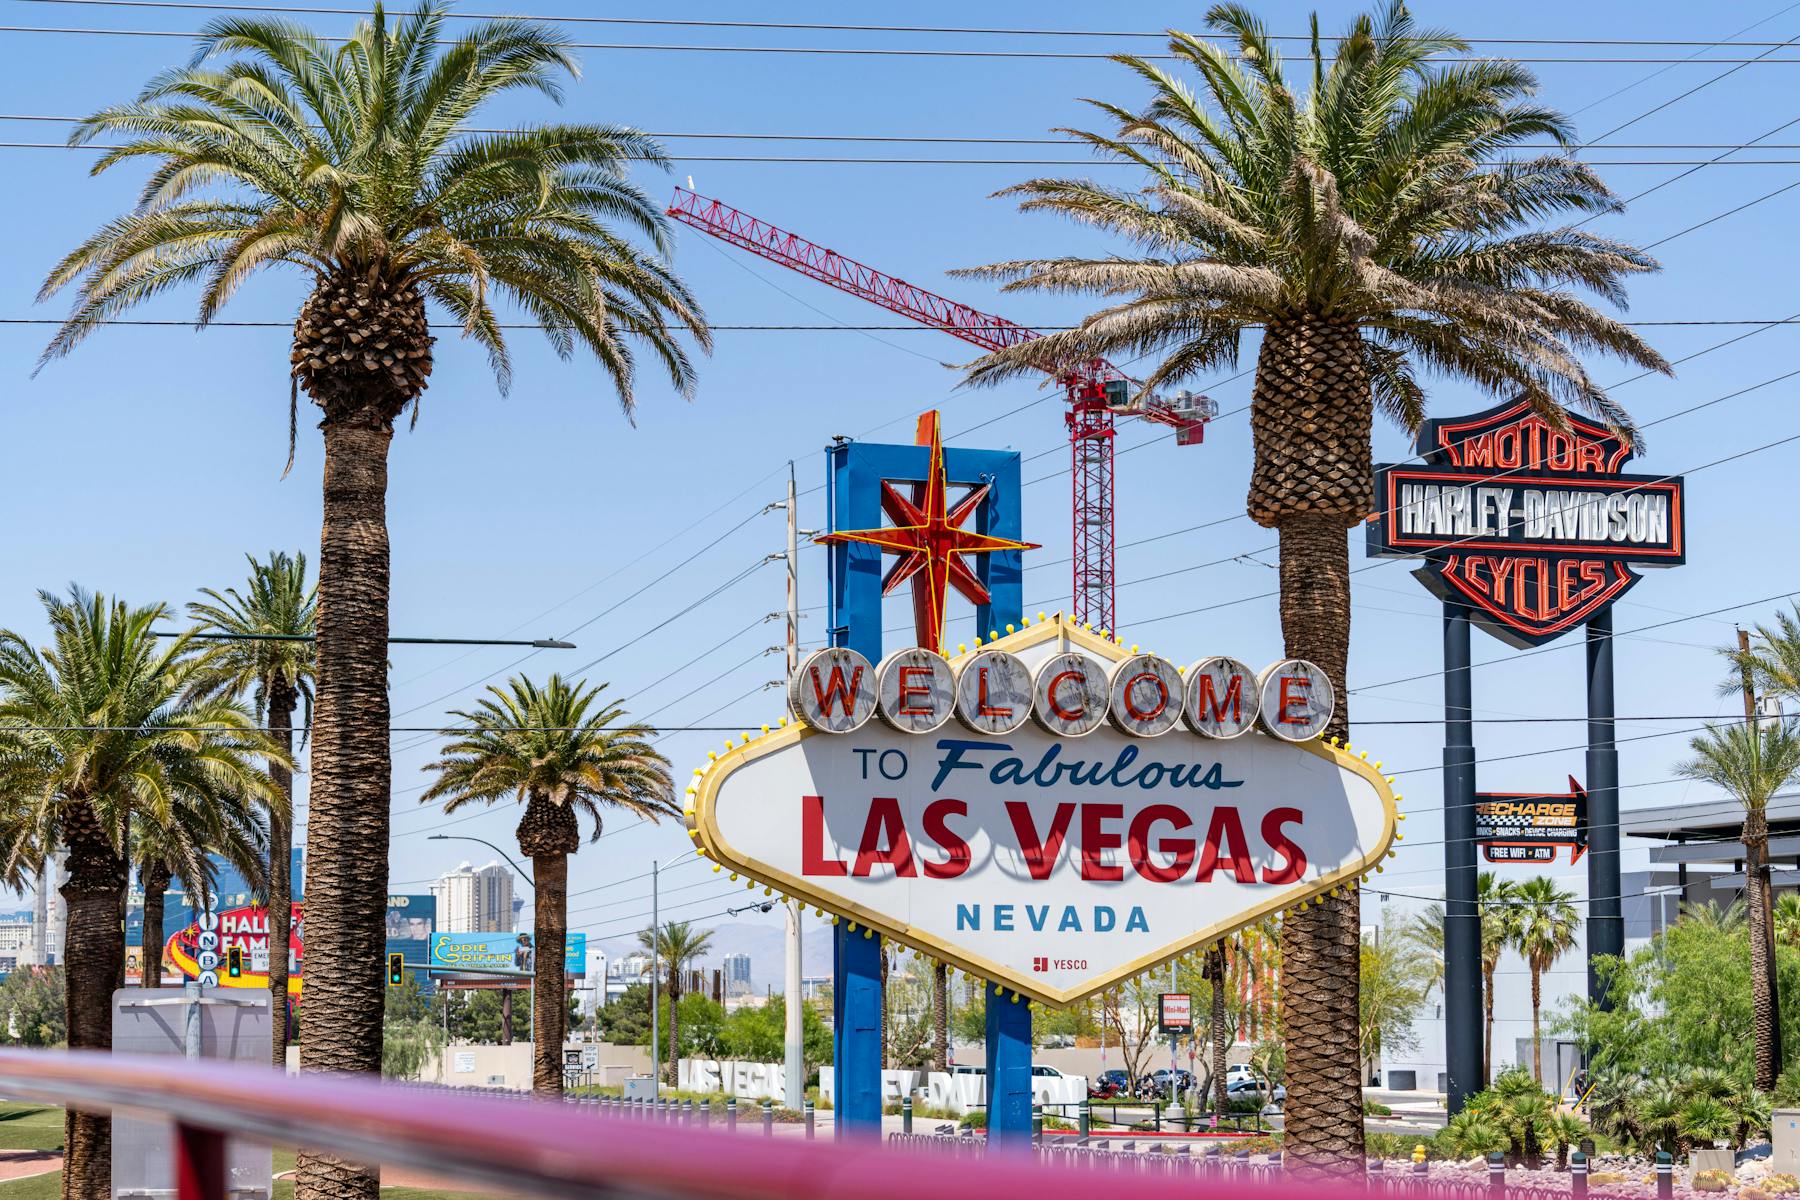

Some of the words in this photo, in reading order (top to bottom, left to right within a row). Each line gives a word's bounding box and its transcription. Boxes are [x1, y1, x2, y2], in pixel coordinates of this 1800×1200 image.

[1463, 414, 1606, 474] MOTOR
[1401, 483, 1669, 544] HARLEY-DAVIDSON
[1464, 555, 1606, 621] CYCLES
[809, 664, 1312, 725] WELCOME
[853, 748, 908, 781] TO
[931, 739, 1245, 792] Fabulous
[1496, 827, 1521, 837] SNACKS
[1525, 828, 1546, 837] DEVICE
[1547, 828, 1578, 837] CHARGING
[1536, 816, 1573, 826] ZONE
[802, 796, 972, 879] LAS
[1005, 801, 1308, 885] VEGAS
[1490, 847, 1509, 858] FREE
[1534, 848, 1550, 858] ATM
[956, 904, 1151, 934] NEVADA
[222, 935, 270, 954] FAM
[434, 936, 488, 955] EDDIE
[444, 952, 513, 963] GRIFFIN
[1053, 959, 1088, 970] YESCO
[678, 1059, 720, 1094] LAS
